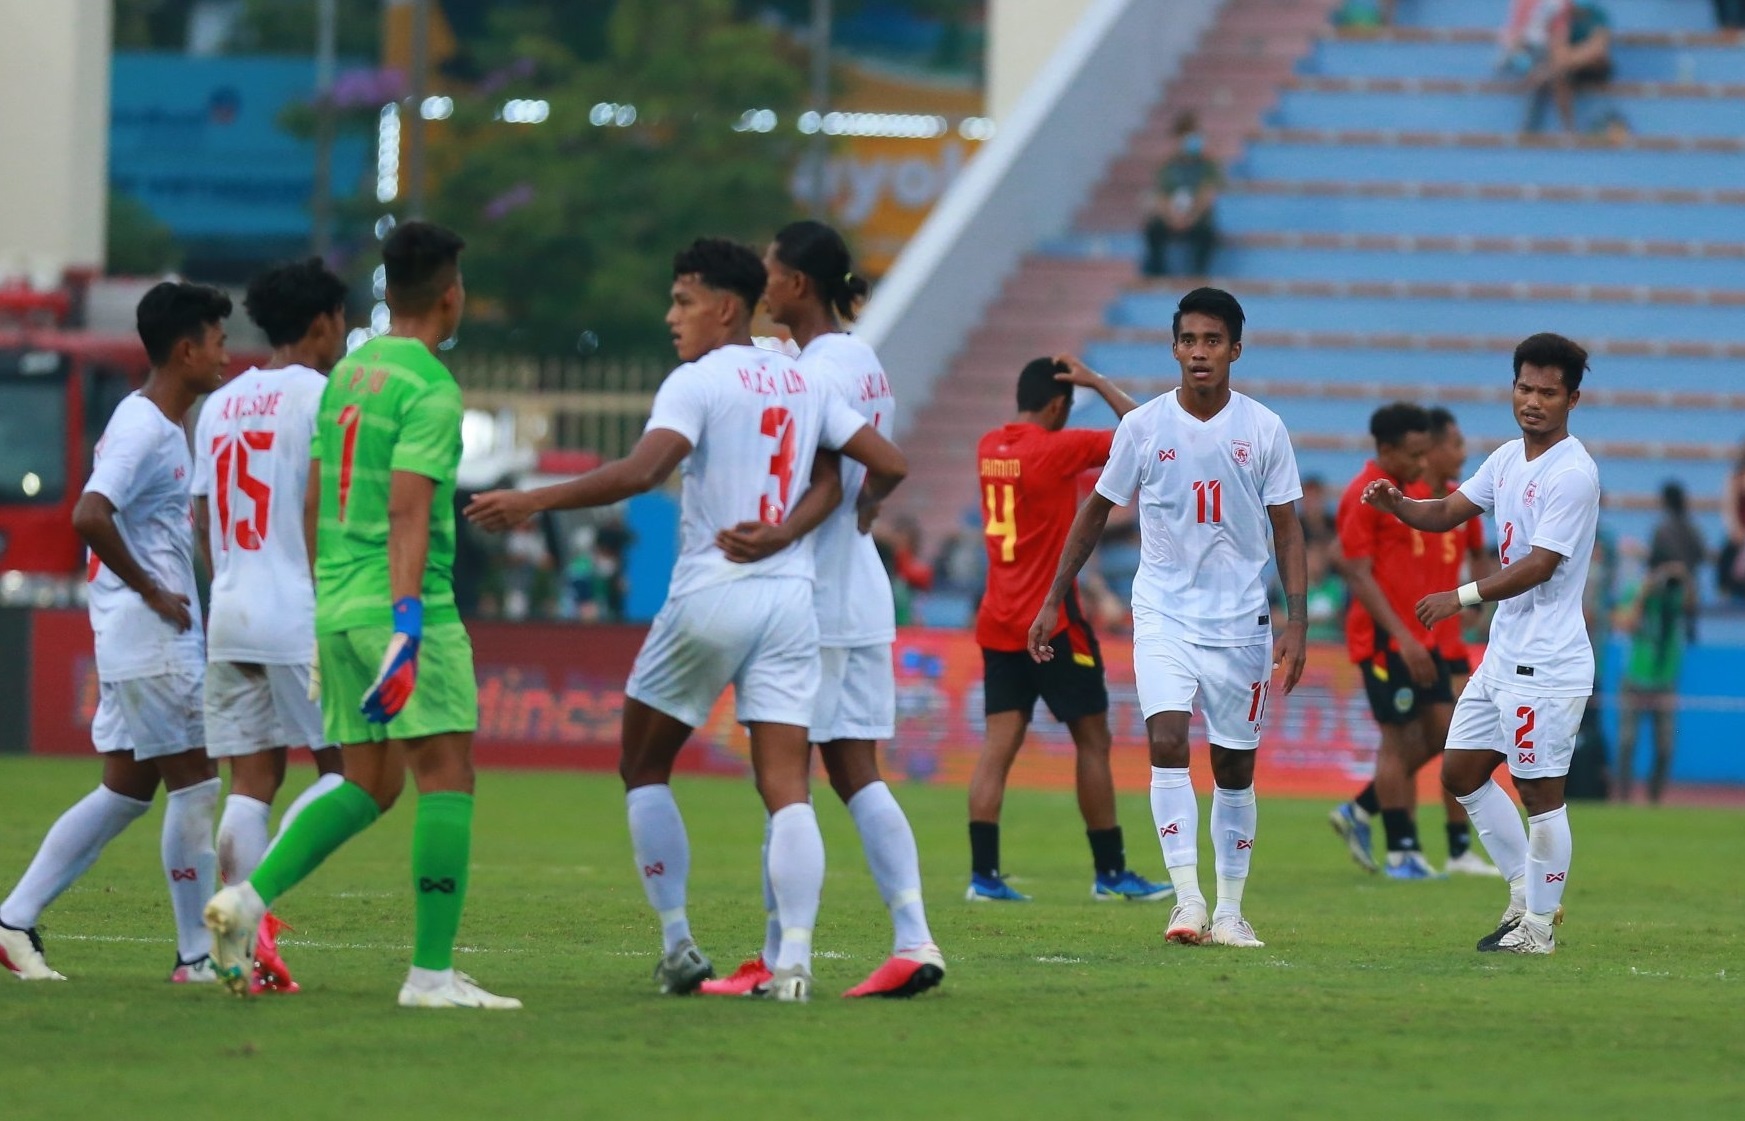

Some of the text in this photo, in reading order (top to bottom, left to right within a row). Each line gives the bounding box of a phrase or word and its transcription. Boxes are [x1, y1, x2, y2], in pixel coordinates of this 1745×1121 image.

[211, 431, 275, 552] 15
[338, 405, 360, 524] 1
[760, 407, 796, 527] 3
[1193, 480, 1221, 524] 11
[985, 484, 1018, 562] 4
[1515, 706, 1535, 749] 2
